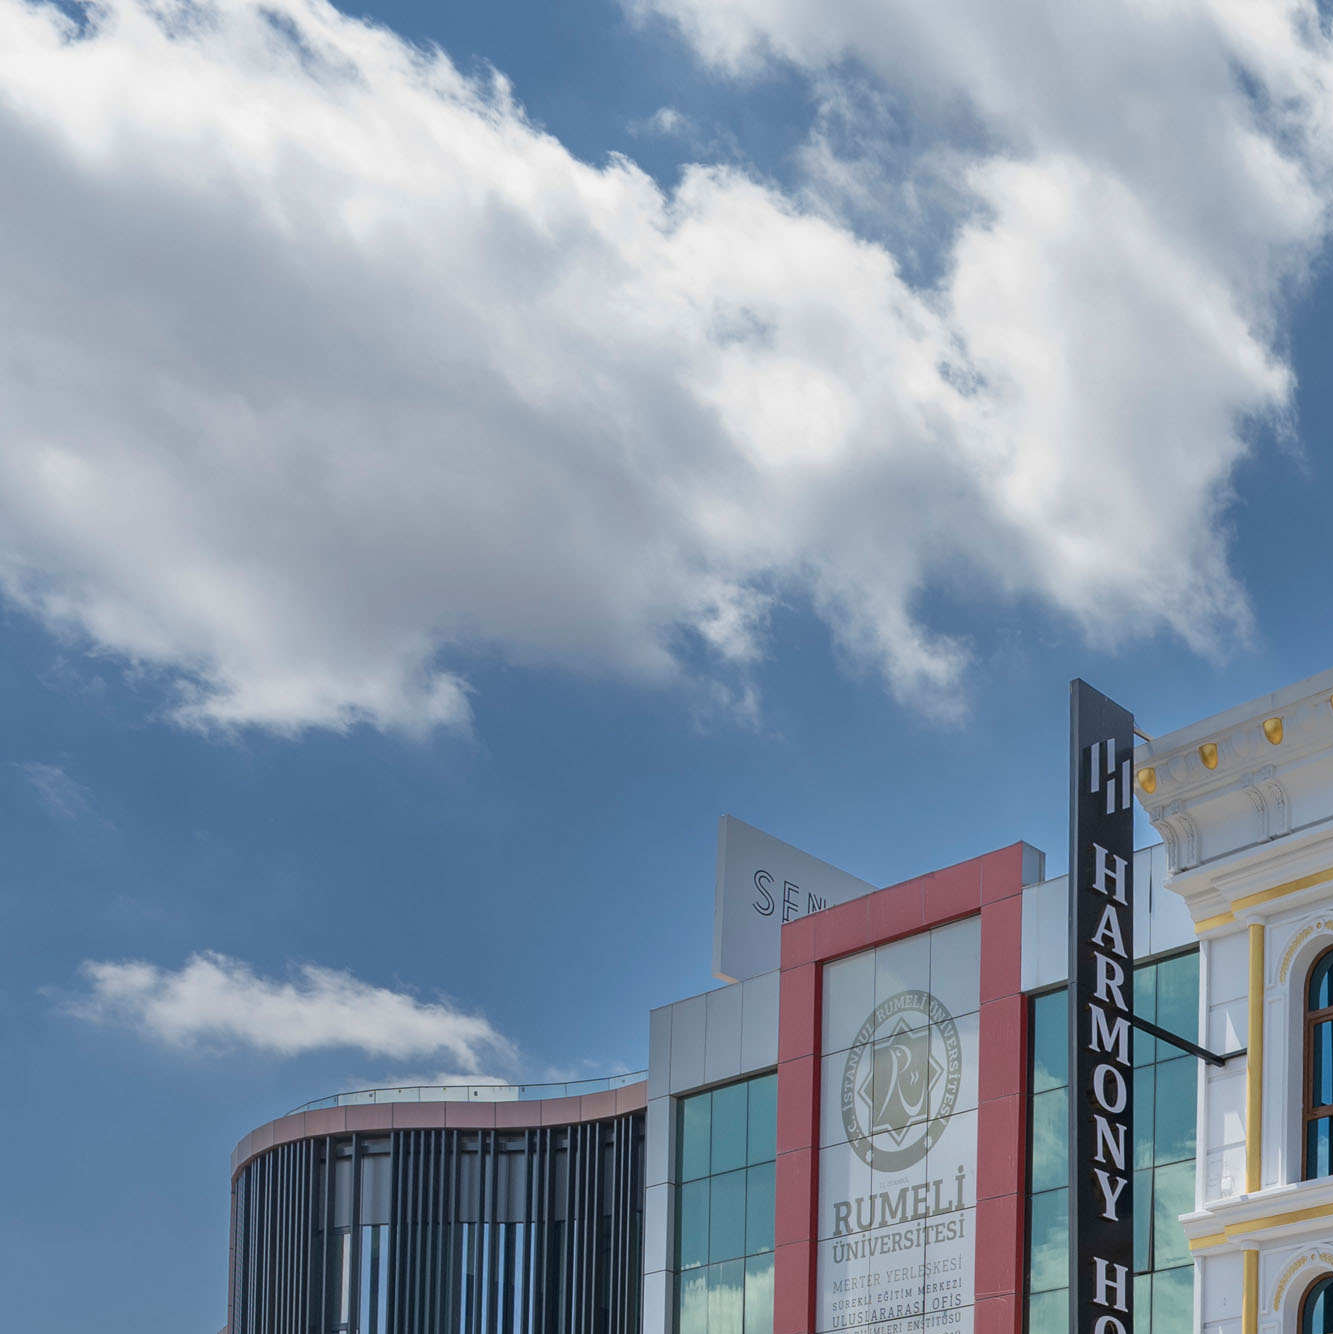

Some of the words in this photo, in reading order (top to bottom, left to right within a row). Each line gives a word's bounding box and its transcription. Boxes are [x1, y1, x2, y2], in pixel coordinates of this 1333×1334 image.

[753, 870, 828, 922] SEN
[876, 992, 928, 1025] RUMELİ
[1088, 842, 1131, 1222] HARMONY
[833, 1164, 966, 1237] RUMELİ
[833, 1212, 965, 1264] ÜNİVERSİTESİ
[833, 1273, 881, 1294] MERTER
[886, 1253, 962, 1283] YERLEŞKESİ
[877, 1286, 912, 1303] EĞİTİM
[917, 1278, 962, 1296] MERKEZİ
[832, 1300, 925, 1328] ULUSLARARASI
[932, 1293, 962, 1310] OFİS
